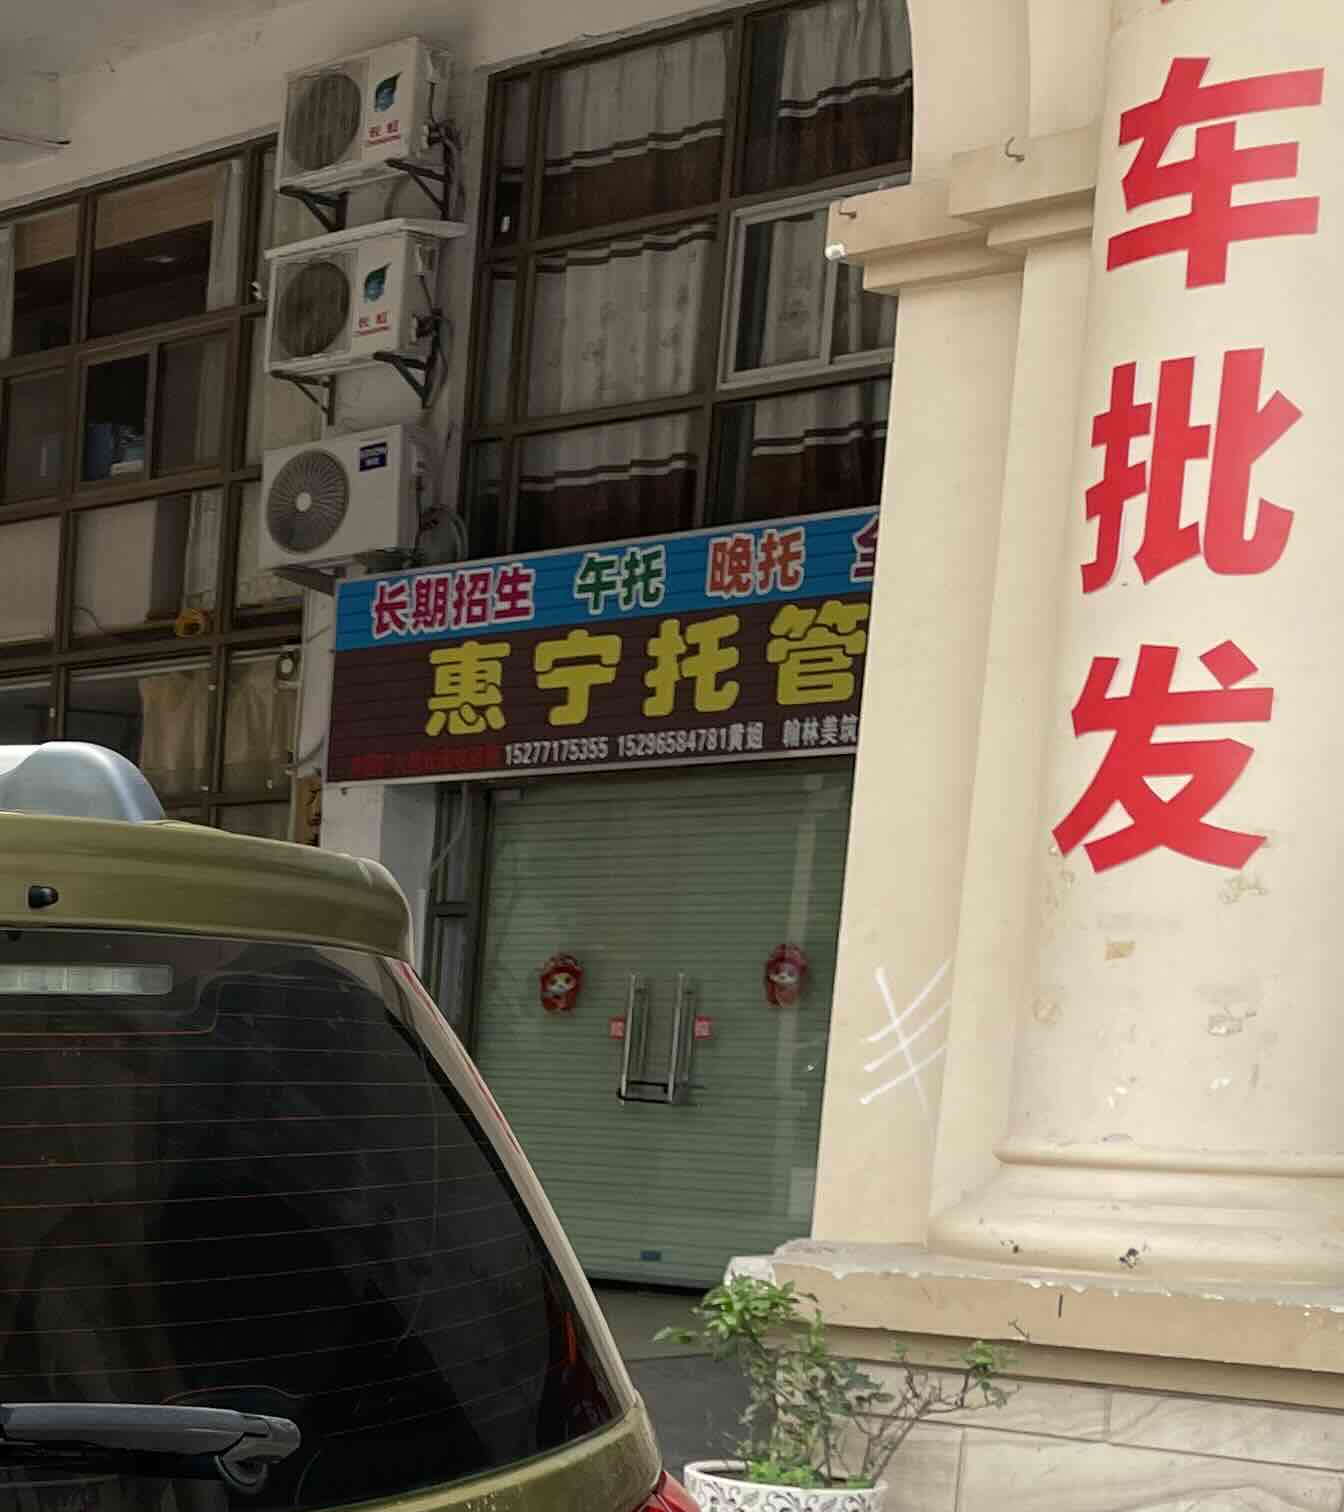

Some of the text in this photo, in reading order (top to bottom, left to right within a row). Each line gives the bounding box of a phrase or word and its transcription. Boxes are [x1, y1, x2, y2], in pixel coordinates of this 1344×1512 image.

[1052, 57, 1324, 873] 车批发
[372, 563, 534, 639] 长期招生
[574, 545, 666, 615] 午托
[706, 527, 806, 597] 晚托
[425, 600, 869, 737] 惠宁托管
